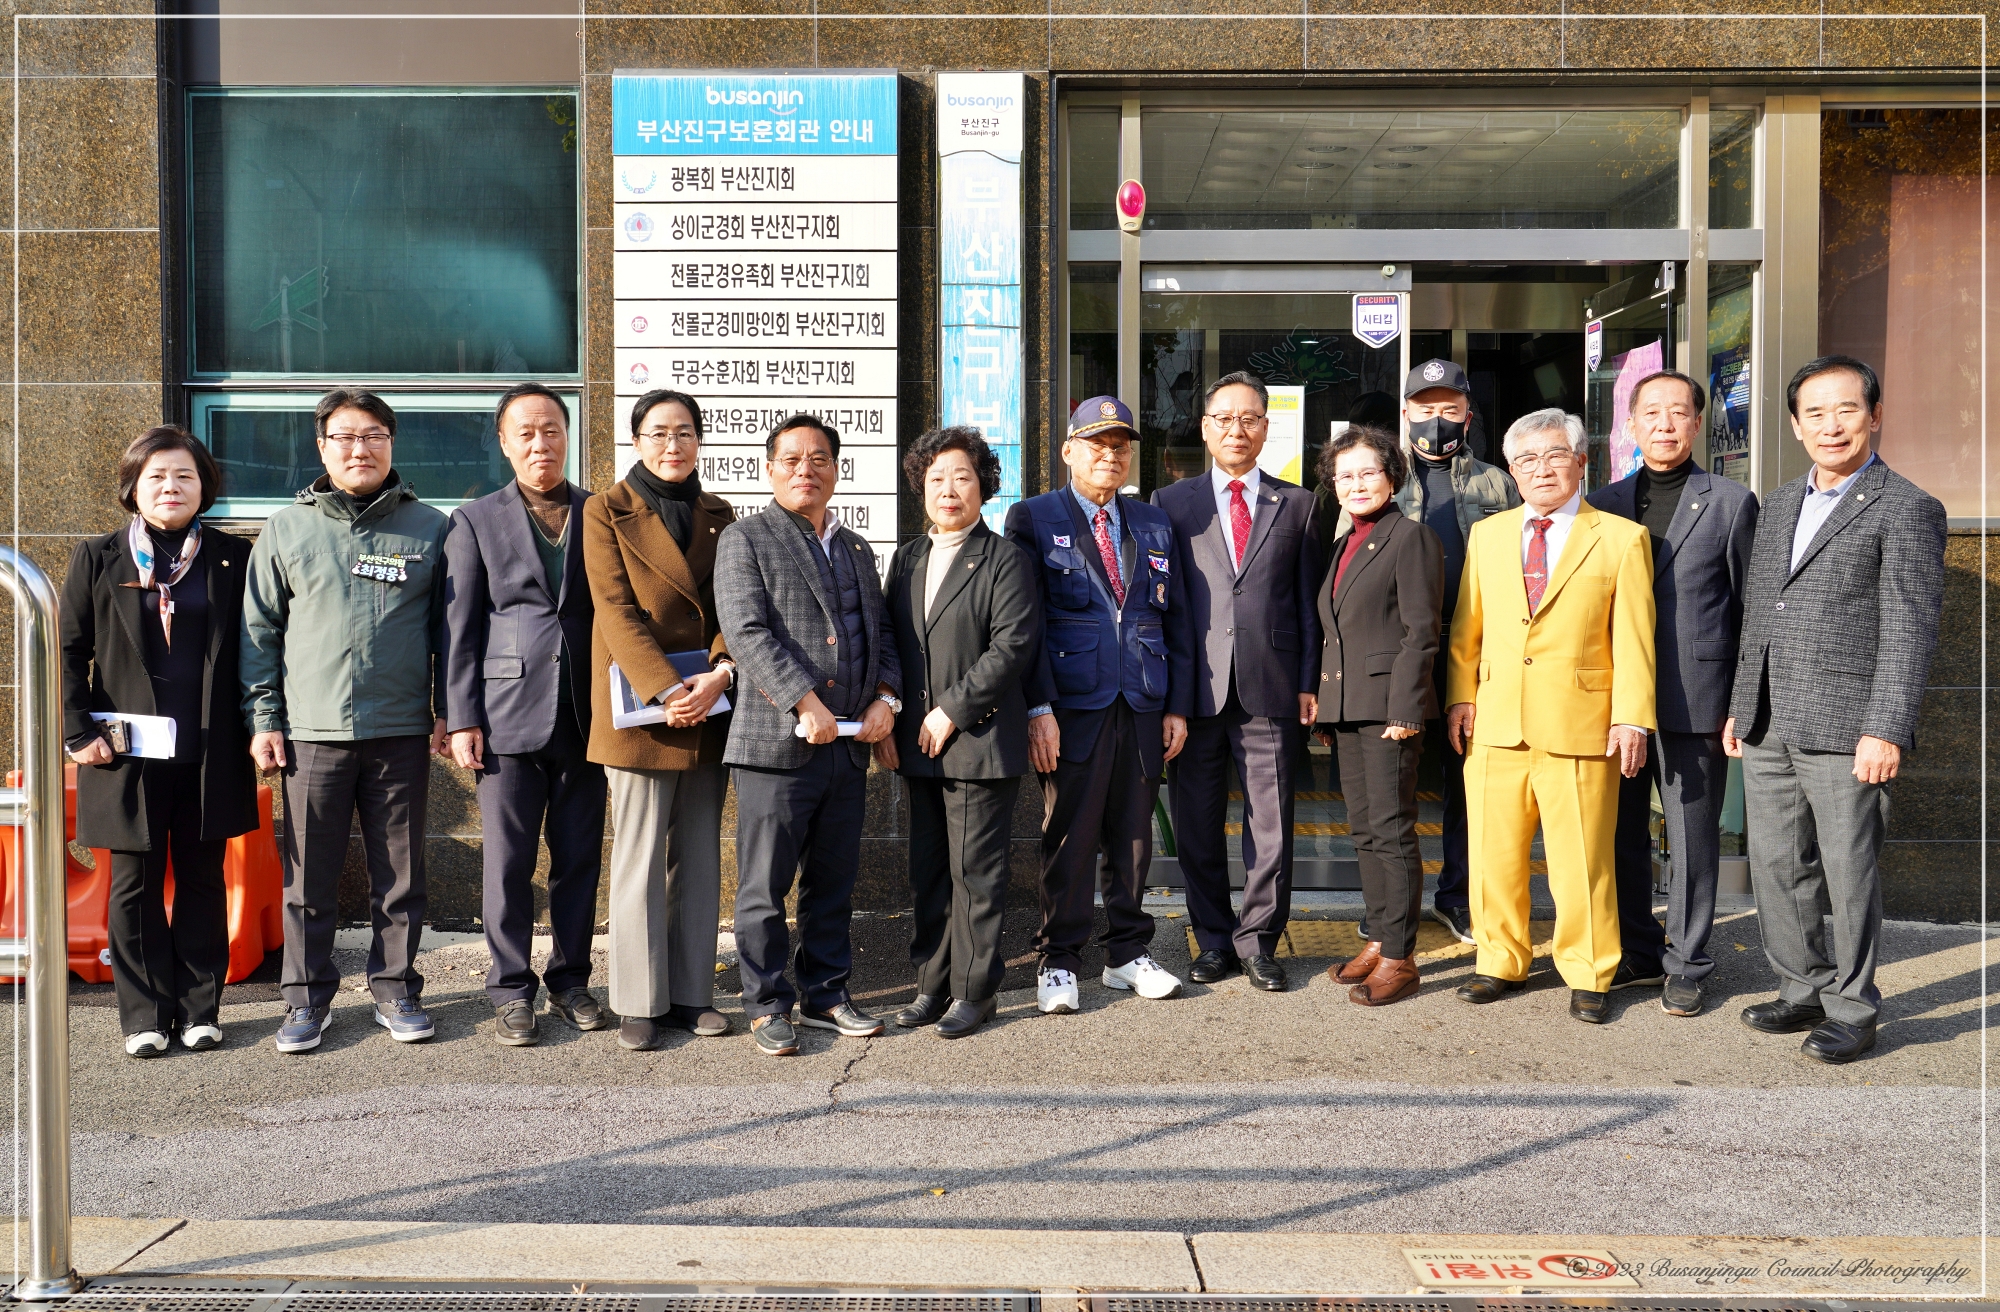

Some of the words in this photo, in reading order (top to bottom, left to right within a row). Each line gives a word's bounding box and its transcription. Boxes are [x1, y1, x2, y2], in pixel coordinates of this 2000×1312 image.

[706, 85, 804, 110] busanjin
[947, 93, 1014, 110] busanjin
[637, 119, 821, 143] 부산진구보훈회관
[829, 119, 873, 143] 안내
[961, 118, 1000, 128] 부산진구
[961, 129, 1000, 137] Busanjin-gu
[671, 166, 714, 192] 광복회
[720, 166, 795, 192] 부산진지회
[671, 214, 744, 240] 상이군경회
[750, 214, 840, 240] 부산진구지회
[671, 263, 774, 289] 전몰군경유족회
[780, 263, 869, 289] 부산진구지회
[1358, 296, 1396, 304] SECURITY
[671, 311, 789, 337] 전몰군경미망인회
[795, 311, 885, 337] 부산진구지회
[671, 359, 760, 386] 무공수훈자회
[766, 359, 855, 386] 부산진구지회
[358, 554, 406, 568] 부산진구의원
[1426, 1262, 1533, 1280] 위험!
